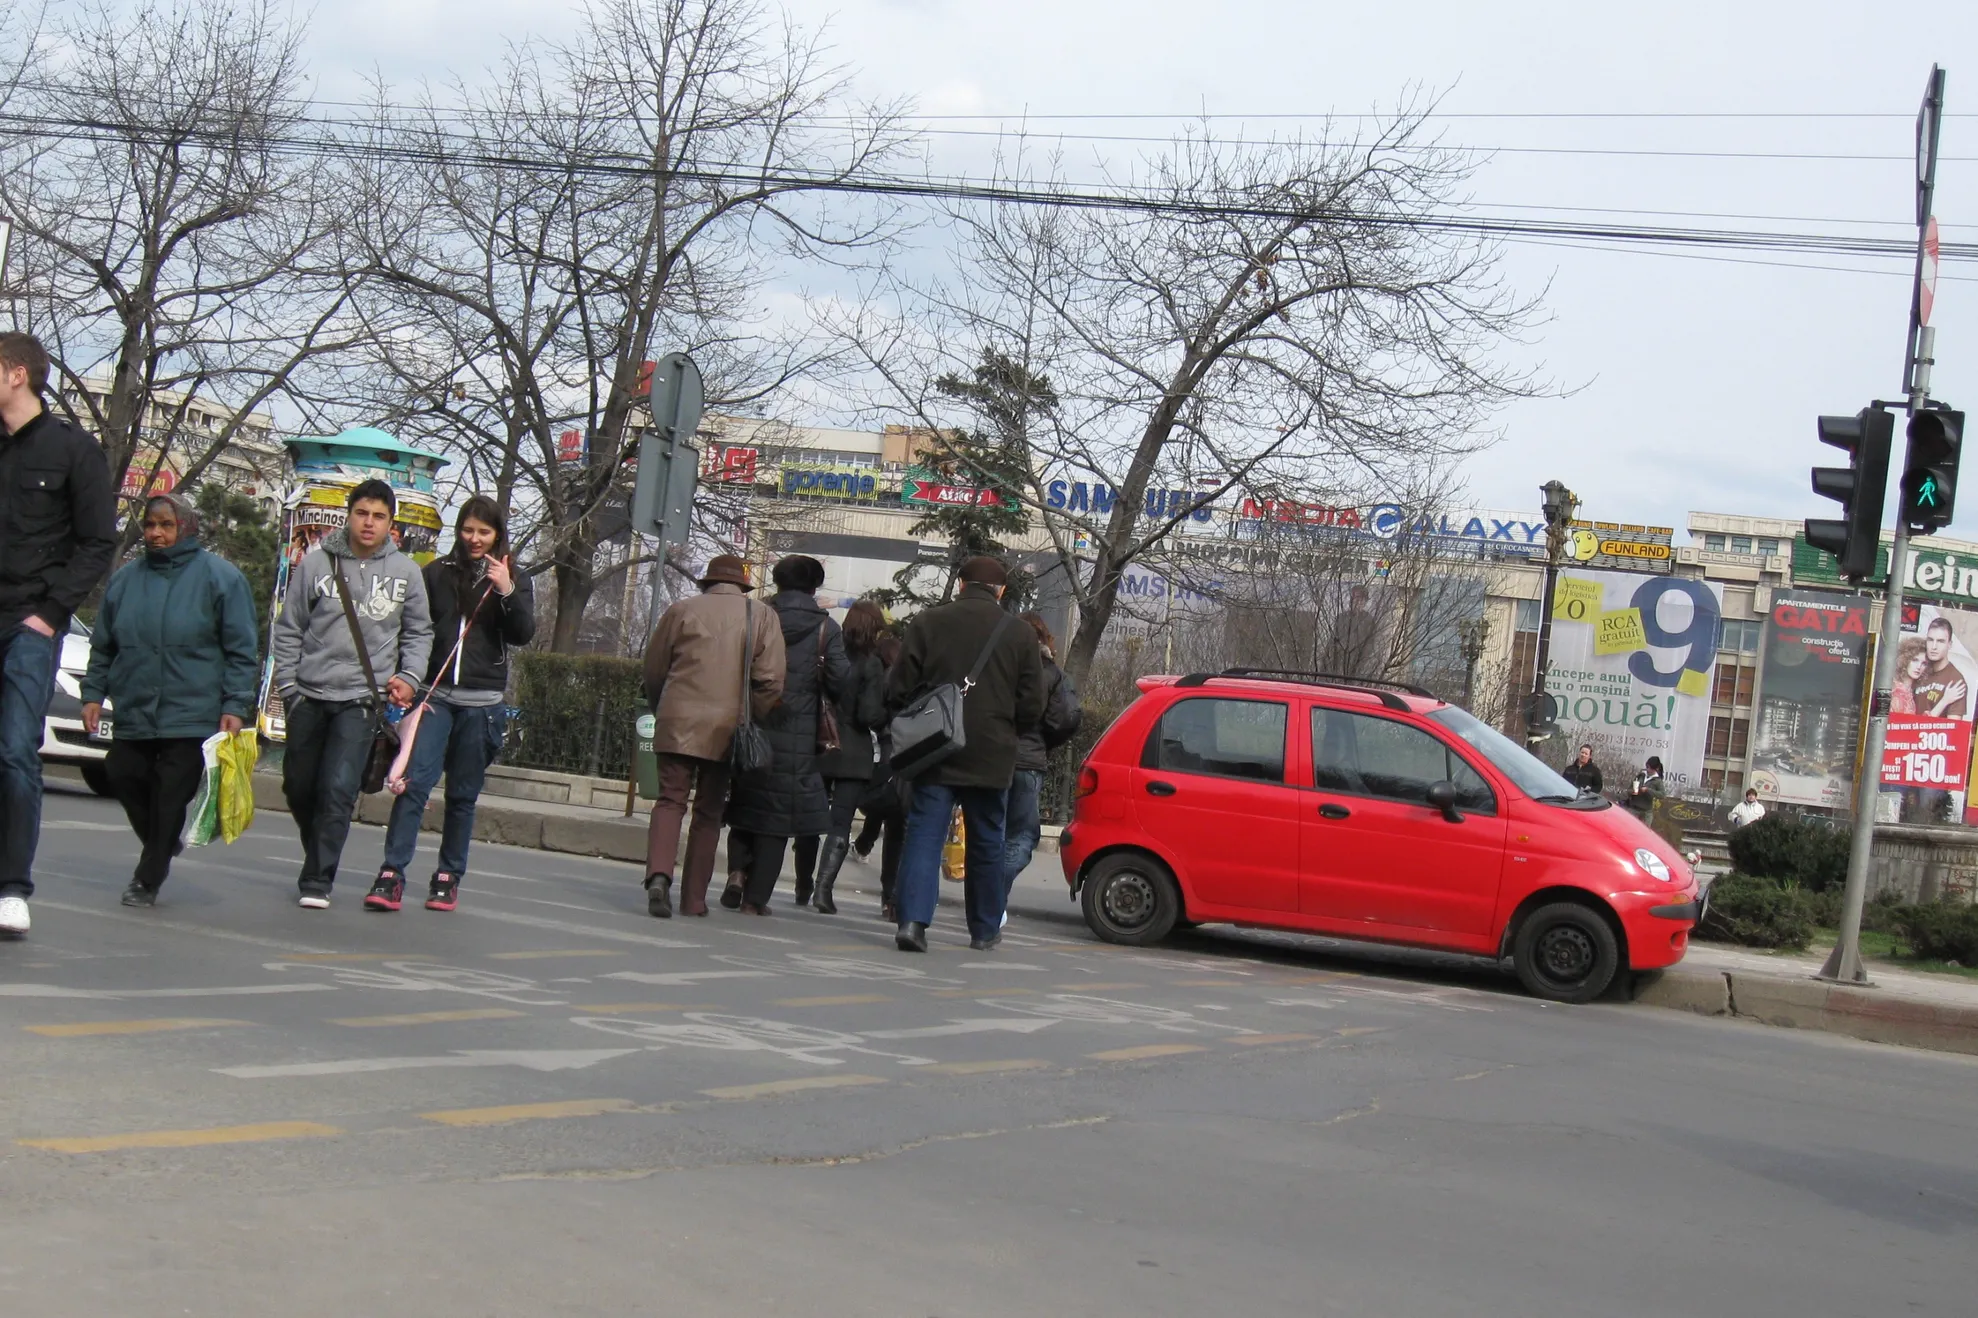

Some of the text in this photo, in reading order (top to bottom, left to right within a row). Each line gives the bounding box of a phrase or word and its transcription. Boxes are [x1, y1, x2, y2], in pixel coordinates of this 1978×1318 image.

[783, 469, 875, 496] gorenje
[1048, 480, 1212, 523] SAMUNG
[297, 508, 348, 527] Mincinos
[1242, 498, 1362, 528] MEDIA
[1606, 543, 1665, 557] FUNLAND
[1776, 598, 1847, 612] APARTAMENTELE
[1602, 615, 1637, 631] RCA
[1774, 605, 1866, 635] GATĂ
[1600, 628, 1640, 645] gratuit
[1628, 576, 1722, 688] 9
[1545, 681, 1561, 690] cu
[1566, 683, 1574, 691] o
[1600, 673, 1632, 684] anul
[1552, 693, 1675, 731] nouă!
[1616, 735, 1669, 749] 312.70.53
[1918, 731, 1947, 751] 300
[1903, 752, 1946, 783] 150
